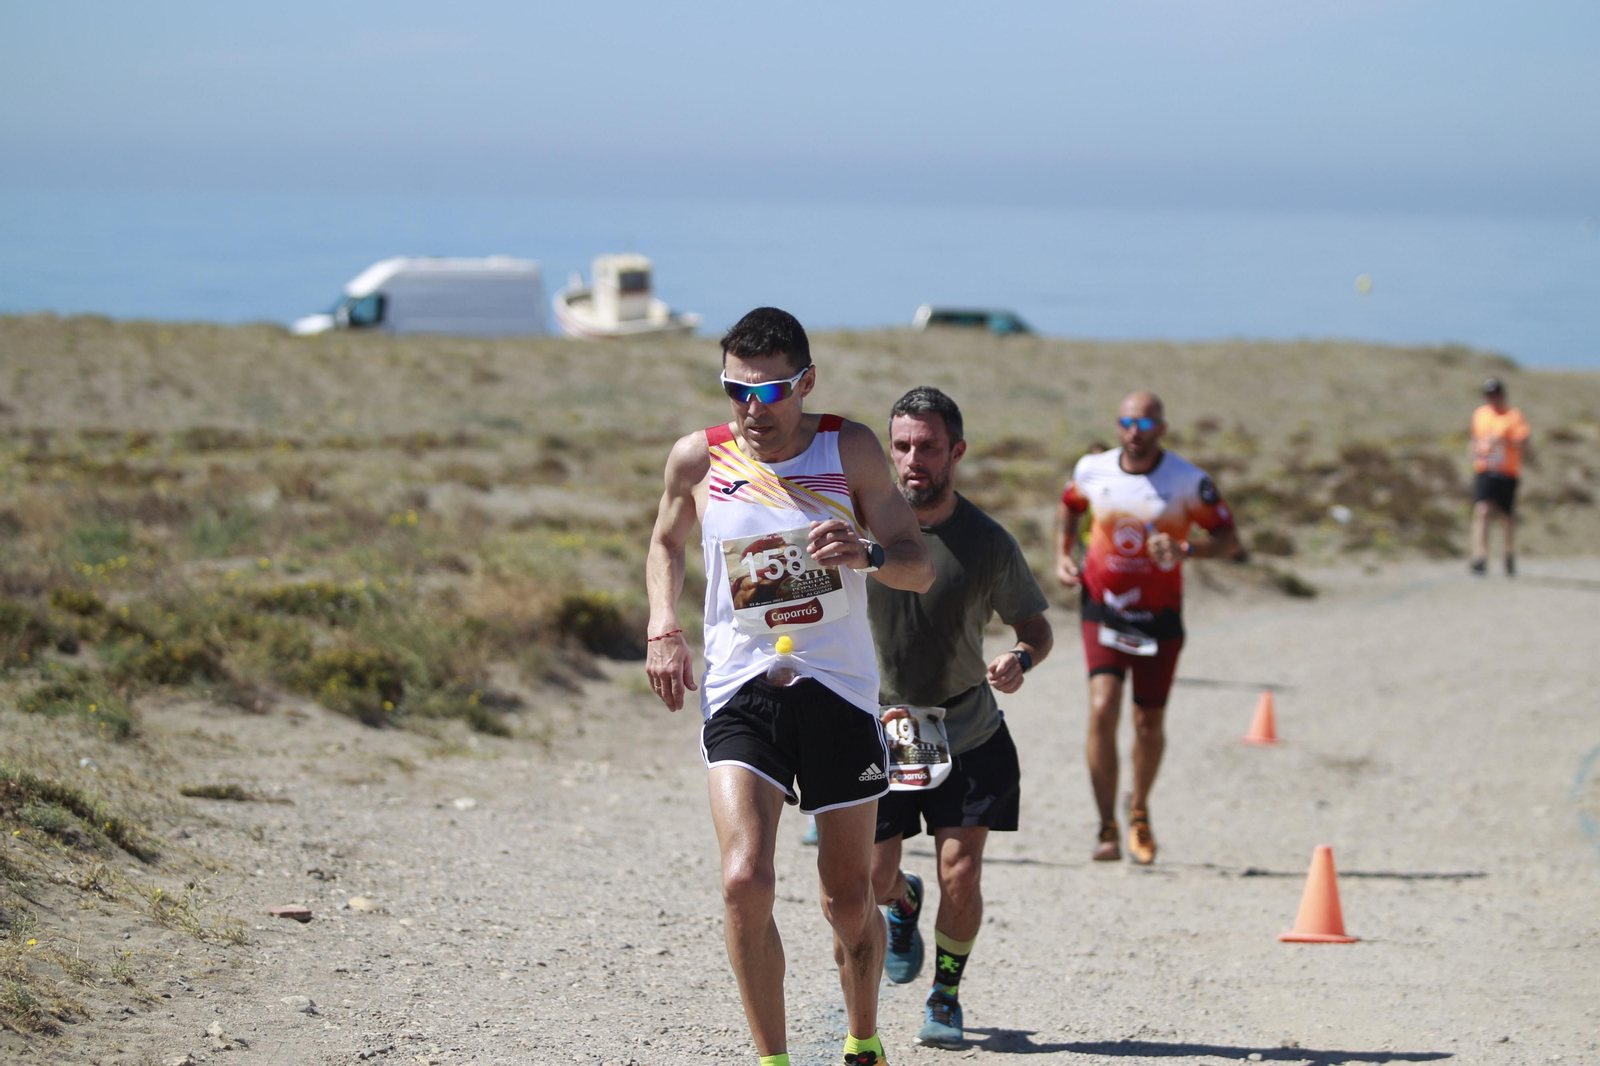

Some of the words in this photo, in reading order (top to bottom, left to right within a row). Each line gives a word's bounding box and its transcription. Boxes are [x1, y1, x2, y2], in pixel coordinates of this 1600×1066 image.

[740, 545, 807, 583] 158
[789, 568, 829, 583] XIII
[790, 576, 831, 588] CARRERA
[791, 580, 831, 592] POPULAR
[771, 604, 818, 623] Caparrós
[858, 772, 886, 782] adidas
